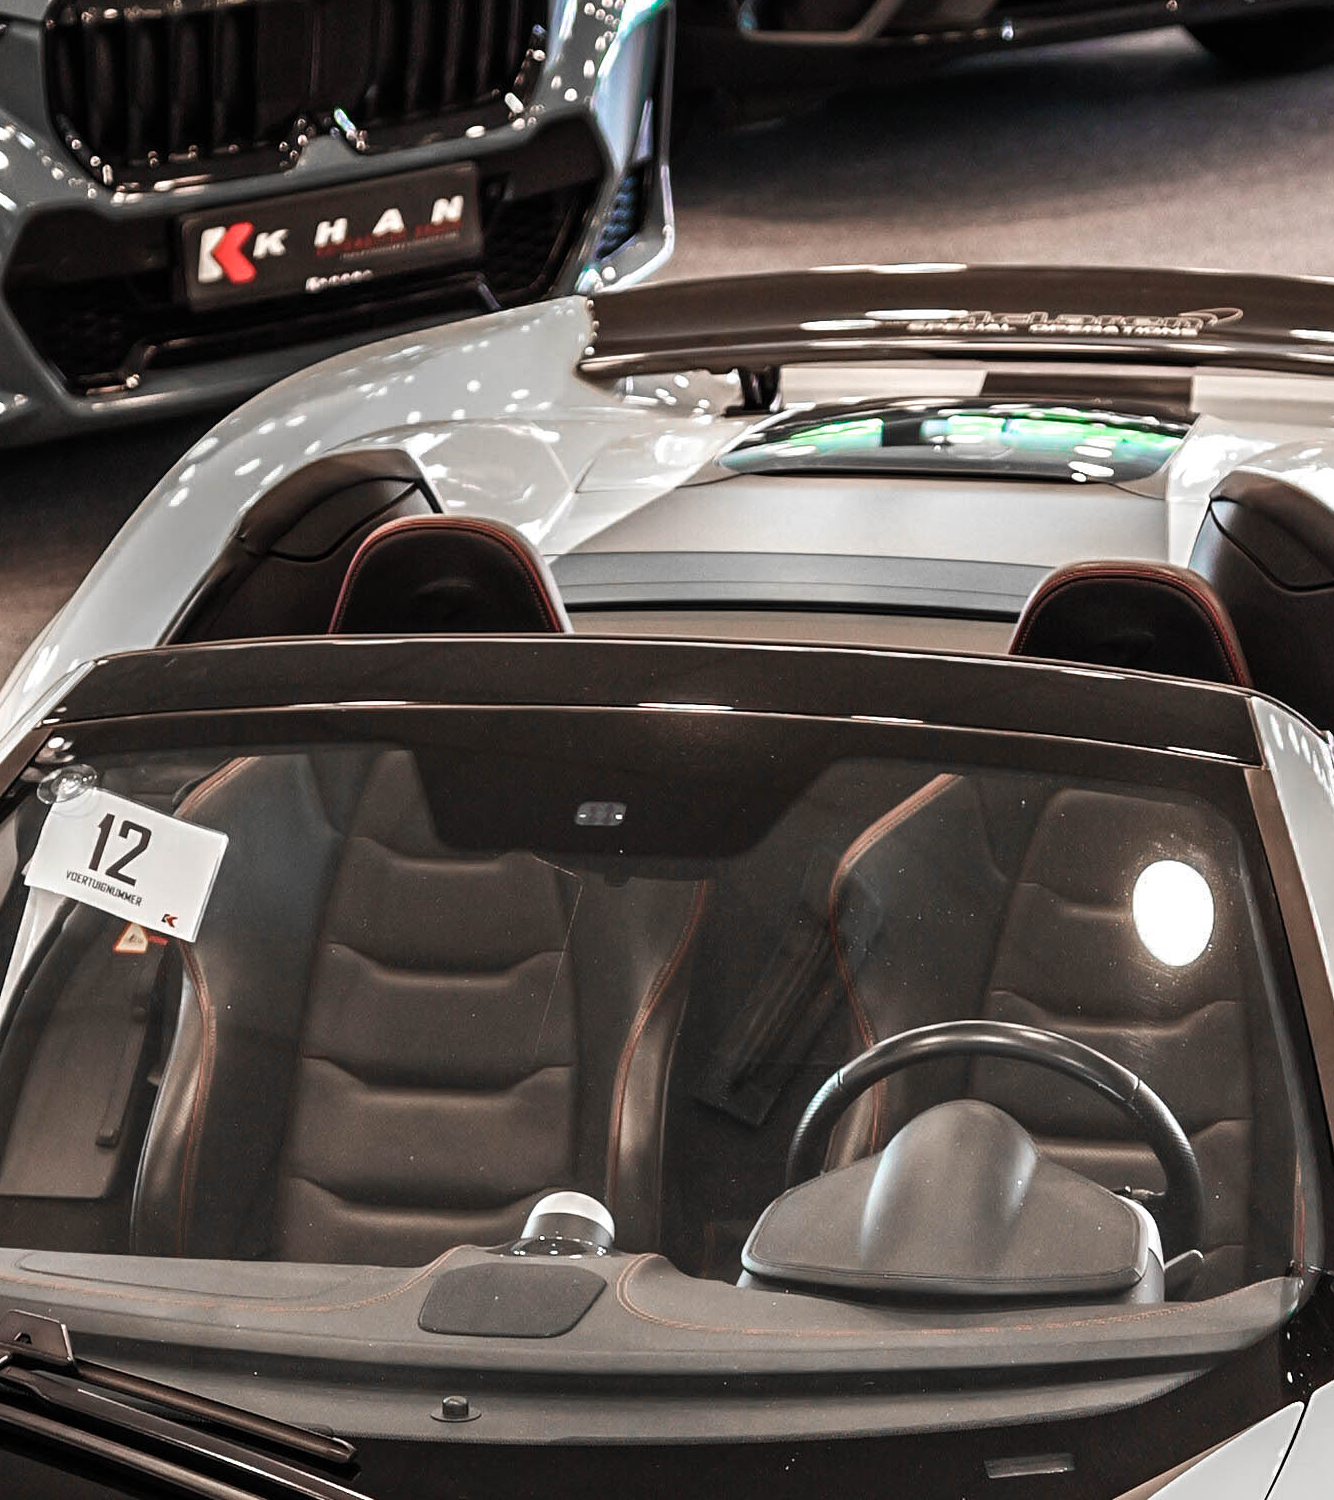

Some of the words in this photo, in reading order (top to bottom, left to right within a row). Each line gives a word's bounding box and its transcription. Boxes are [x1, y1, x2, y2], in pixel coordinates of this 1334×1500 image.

[252, 195, 464, 259] KHAN
[88, 813, 152, 887] 12
[66, 870, 142, 907] VOERTUIGNUMMER
